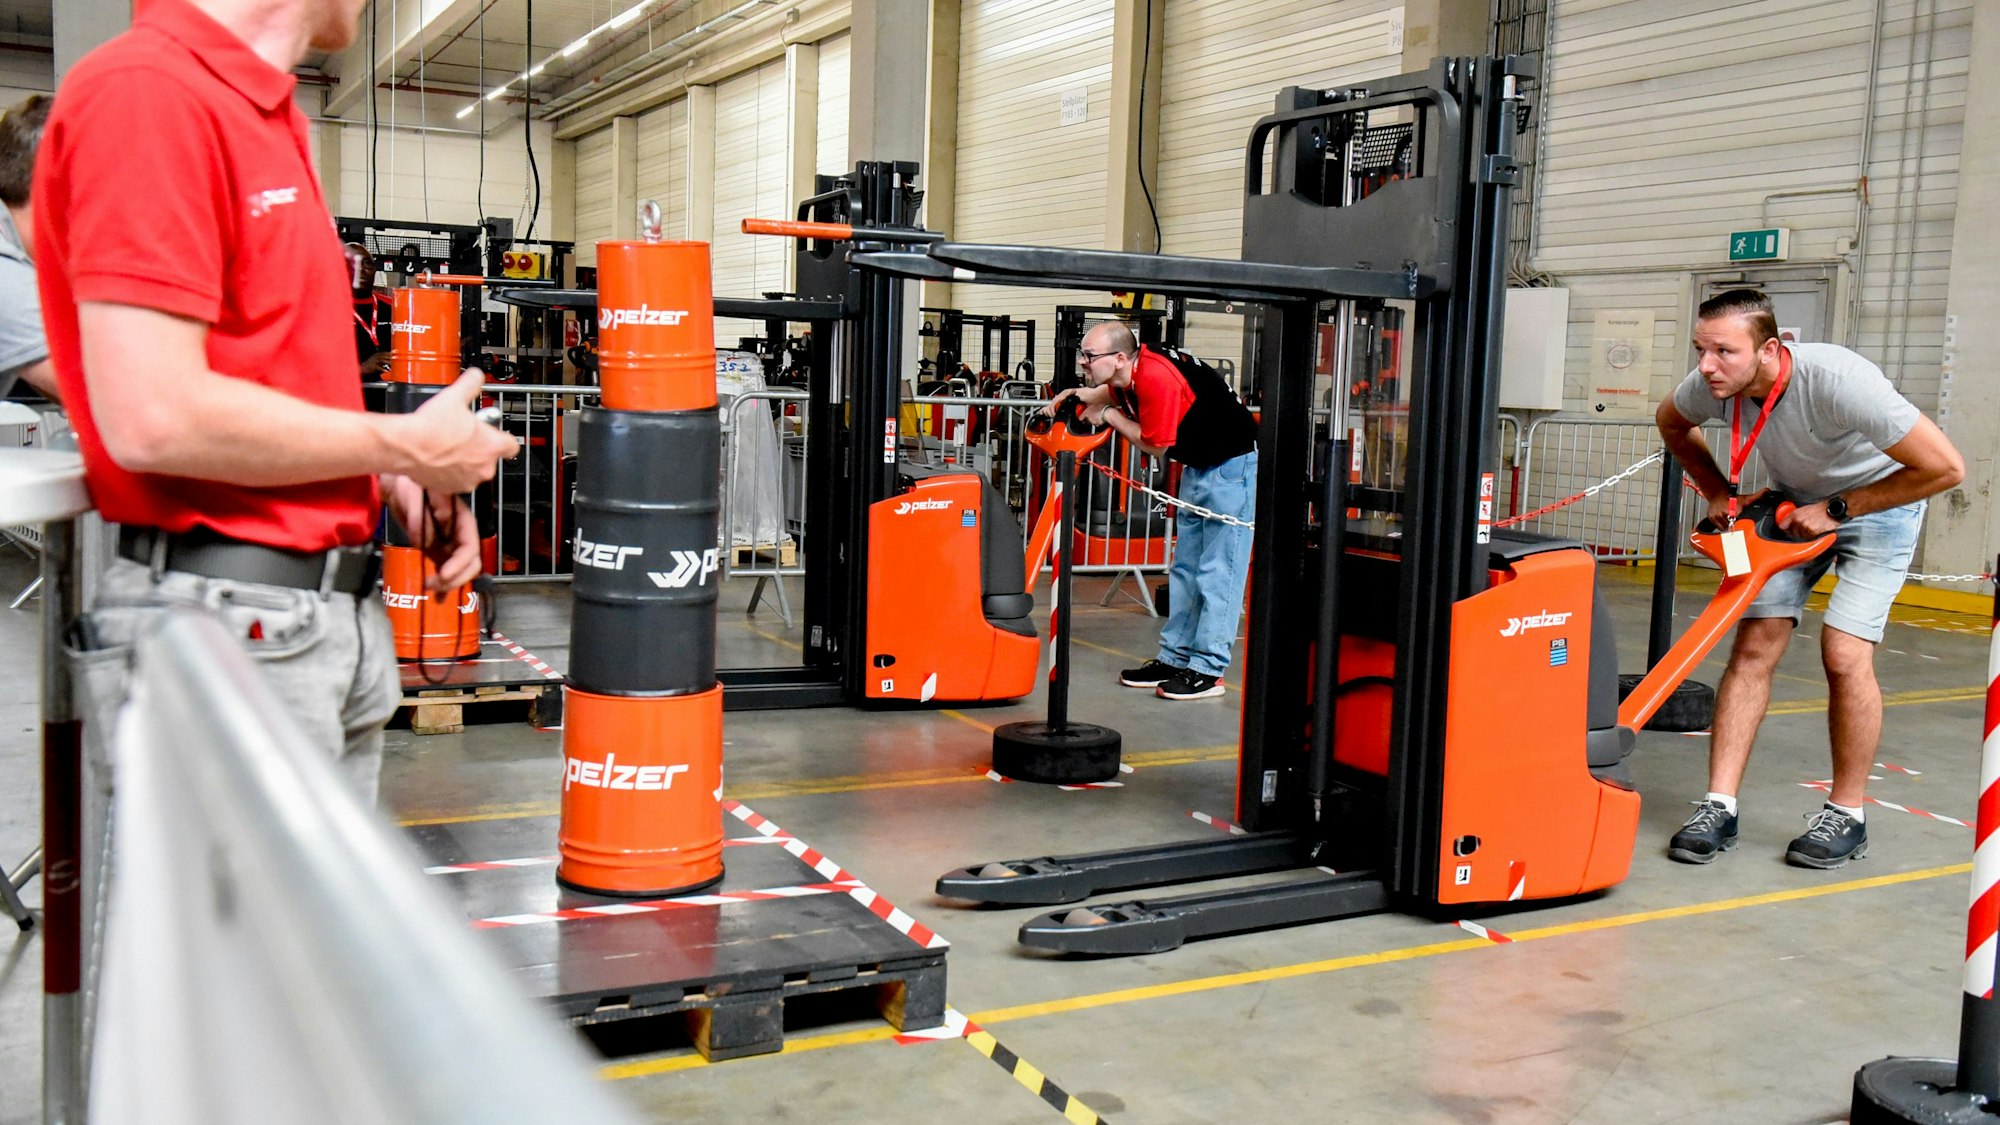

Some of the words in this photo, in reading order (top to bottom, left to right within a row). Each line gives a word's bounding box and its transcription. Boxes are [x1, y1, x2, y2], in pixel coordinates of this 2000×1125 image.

[612, 303, 689, 331] pelzer
[911, 497, 953, 514] pelzer
[1520, 609, 1573, 635] pelzer
[1552, 639, 1566, 648] PB
[565, 752, 690, 792] pelzer
